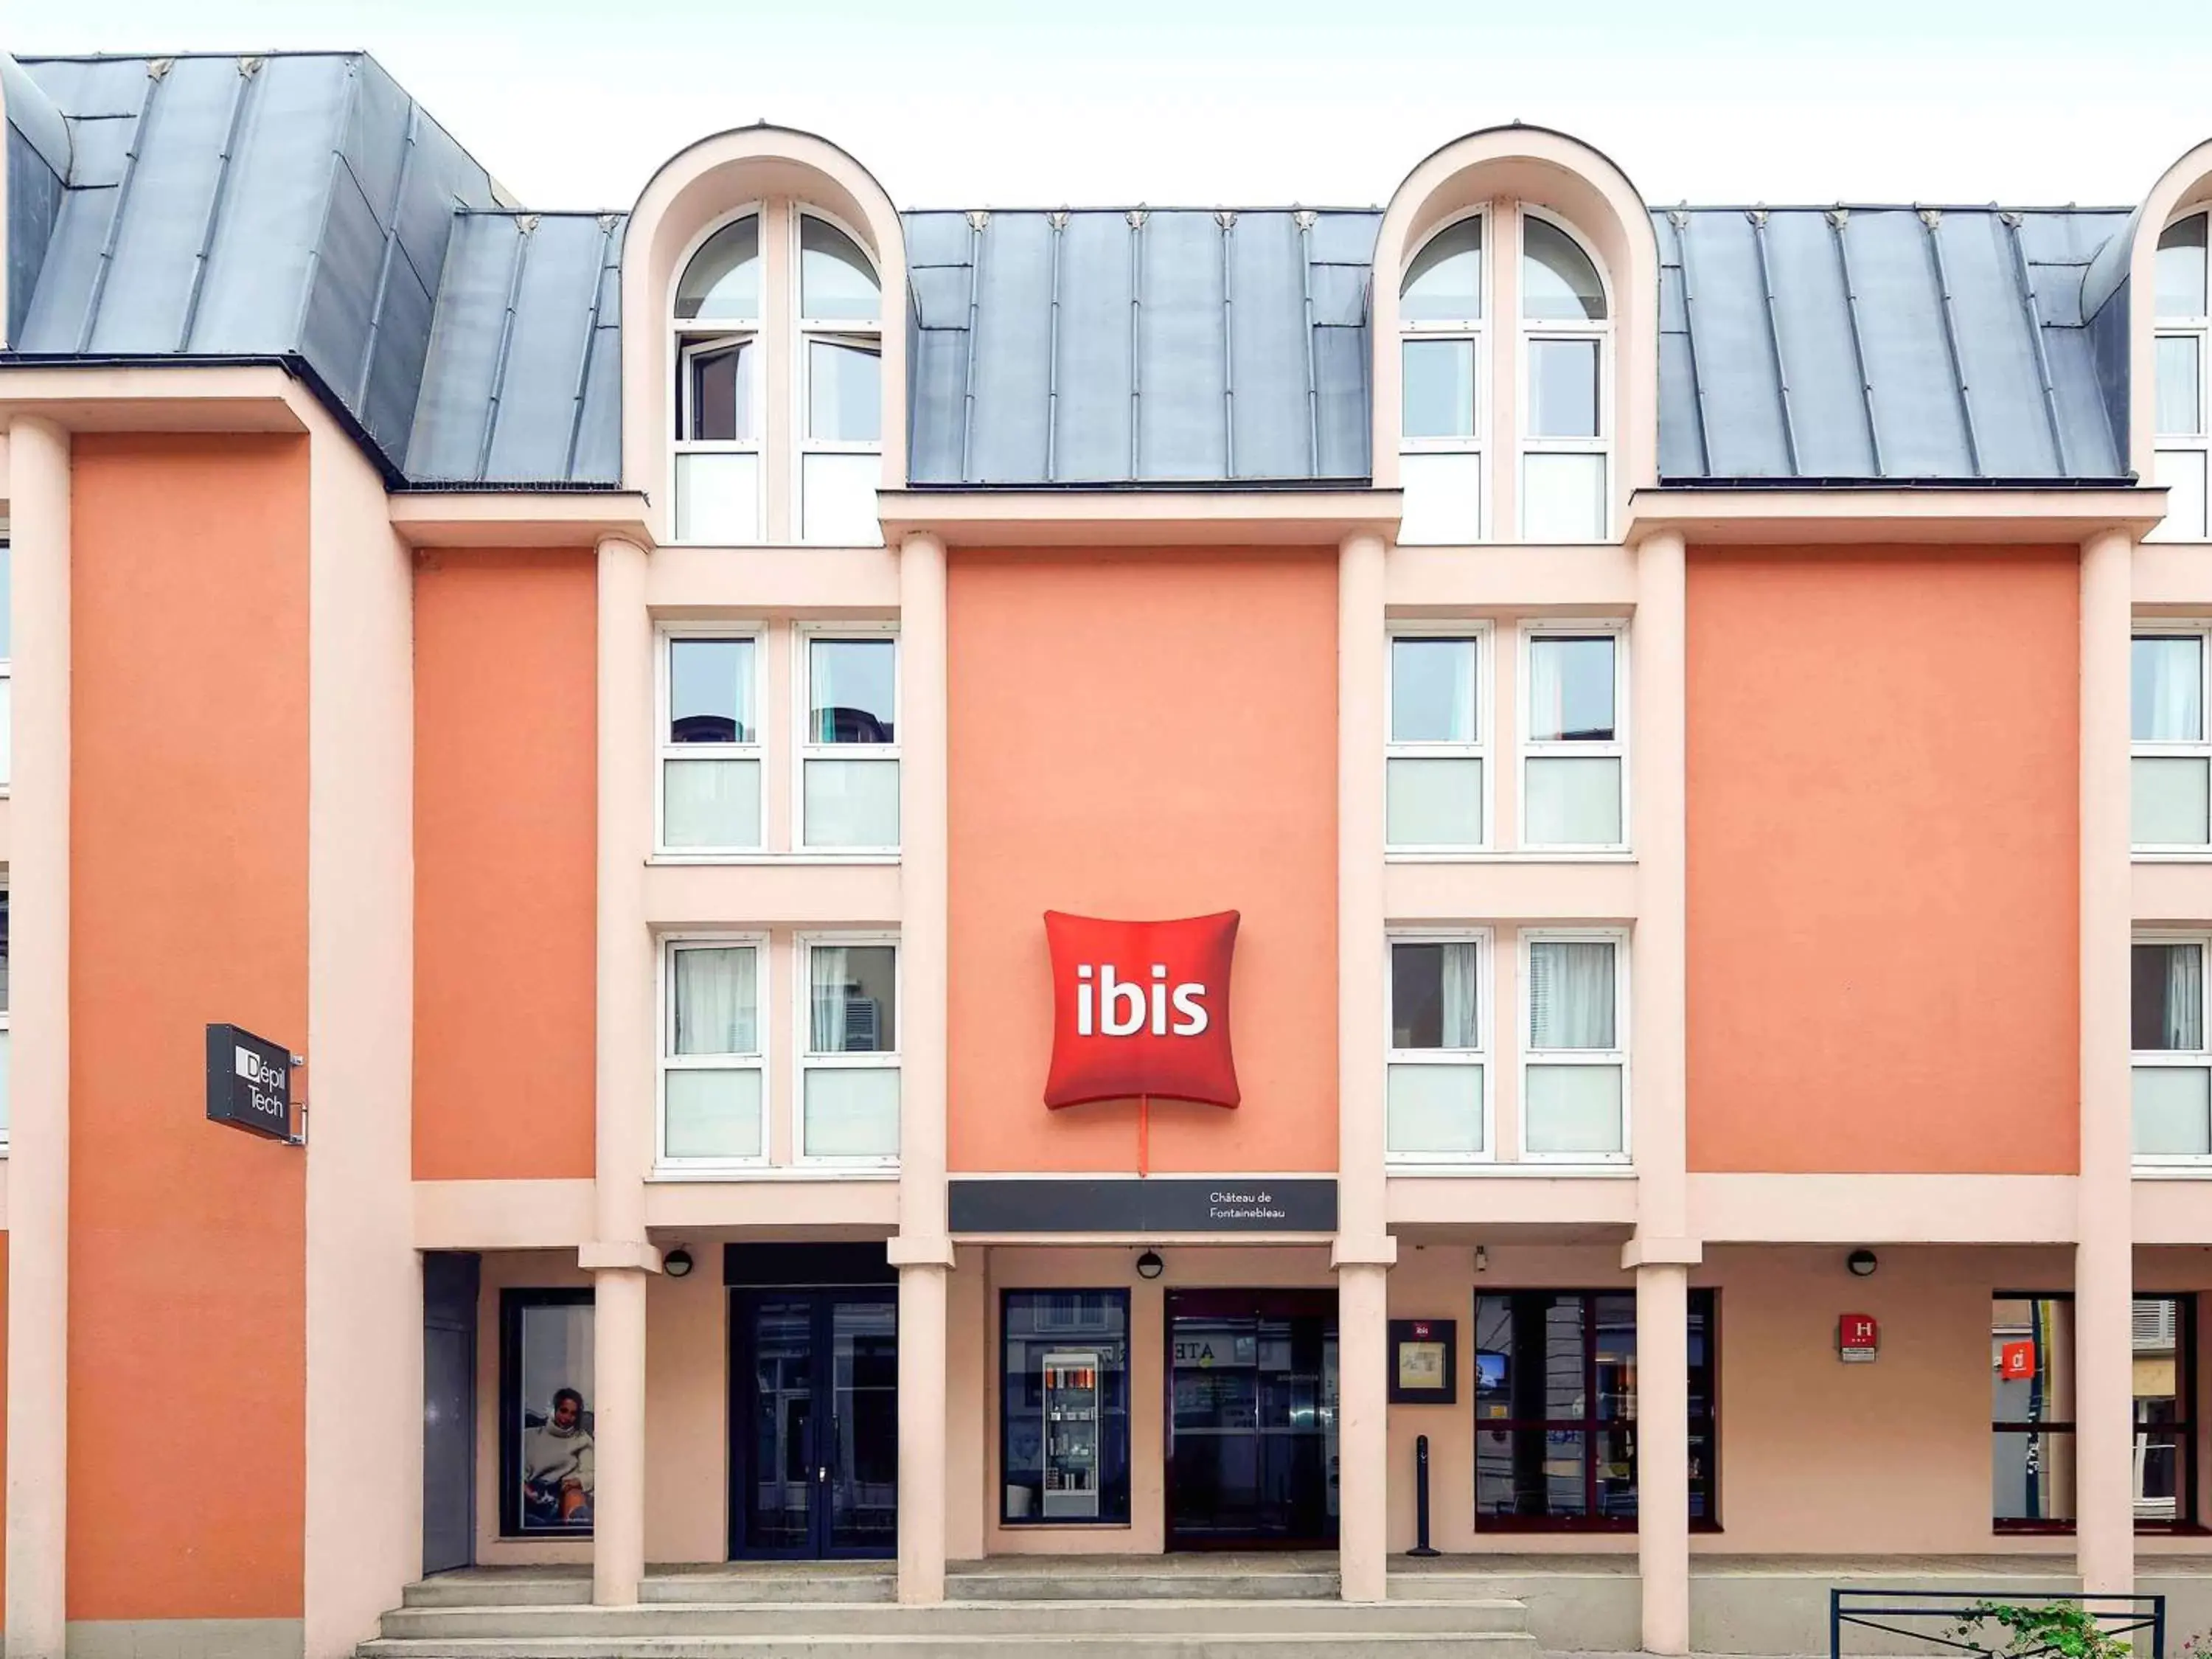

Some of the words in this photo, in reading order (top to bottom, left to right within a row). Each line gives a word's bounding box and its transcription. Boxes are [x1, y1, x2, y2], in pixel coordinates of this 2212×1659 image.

[1077, 964, 1209, 1036] ibis
[248, 1054, 285, 1092] Dépil
[248, 1085, 284, 1119] Tech
[1210, 1192, 1255, 1203] Château
[1257, 1192, 1273, 1203] de
[1210, 1207, 1285, 1218] Fontainebleau
[1855, 1322, 1873, 1336] H
